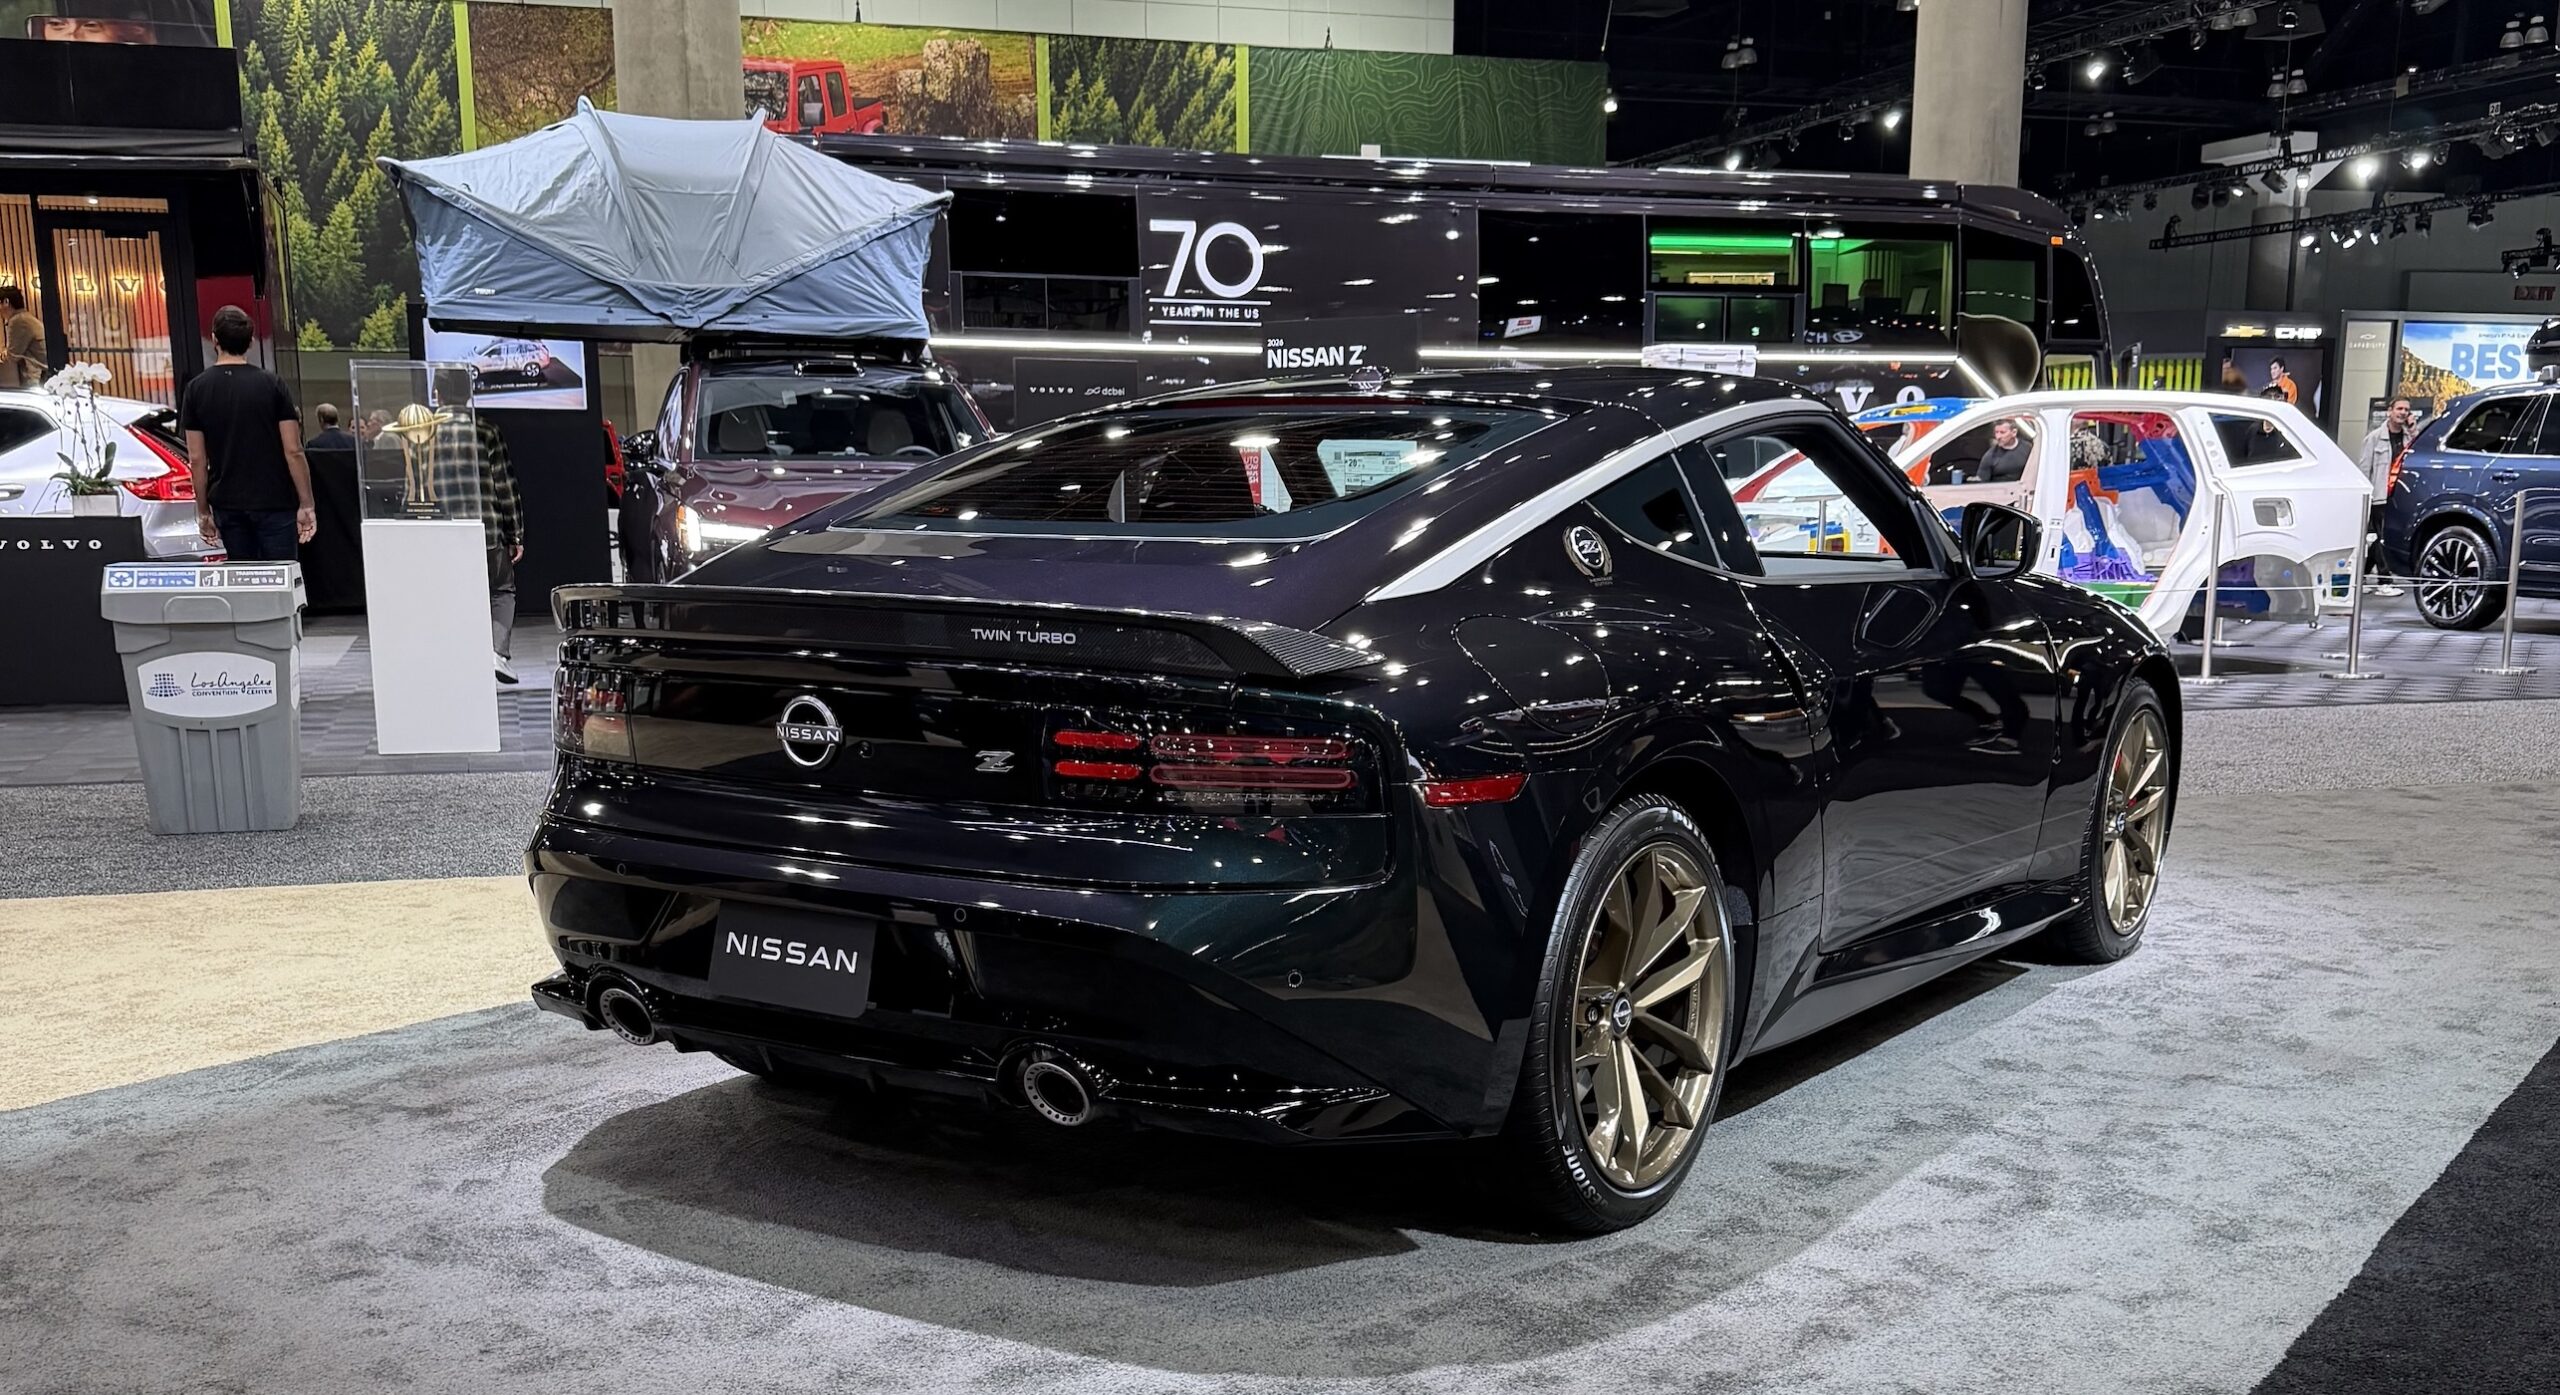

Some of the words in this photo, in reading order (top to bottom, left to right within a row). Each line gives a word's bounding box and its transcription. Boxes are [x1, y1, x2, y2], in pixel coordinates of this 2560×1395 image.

[1149, 219, 1264, 298] 70
[1161, 306, 1198, 318] YEARS
[1202, 307, 1214, 318] IN
[1219, 308, 1240, 319] THE
[1244, 308, 1260, 319] US
[1267, 346, 1345, 369] NISSAN
[1349, 345, 1364, 366] Z
[2451, 343, 2535, 380] BES
[1029, 386, 1074, 394] VOLVO
[971, 628, 1011, 642] TWIN
[1016, 630, 1077, 645] TURBO
[776, 725, 841, 742] NISSAN
[725, 931, 858, 974] NISSAN
